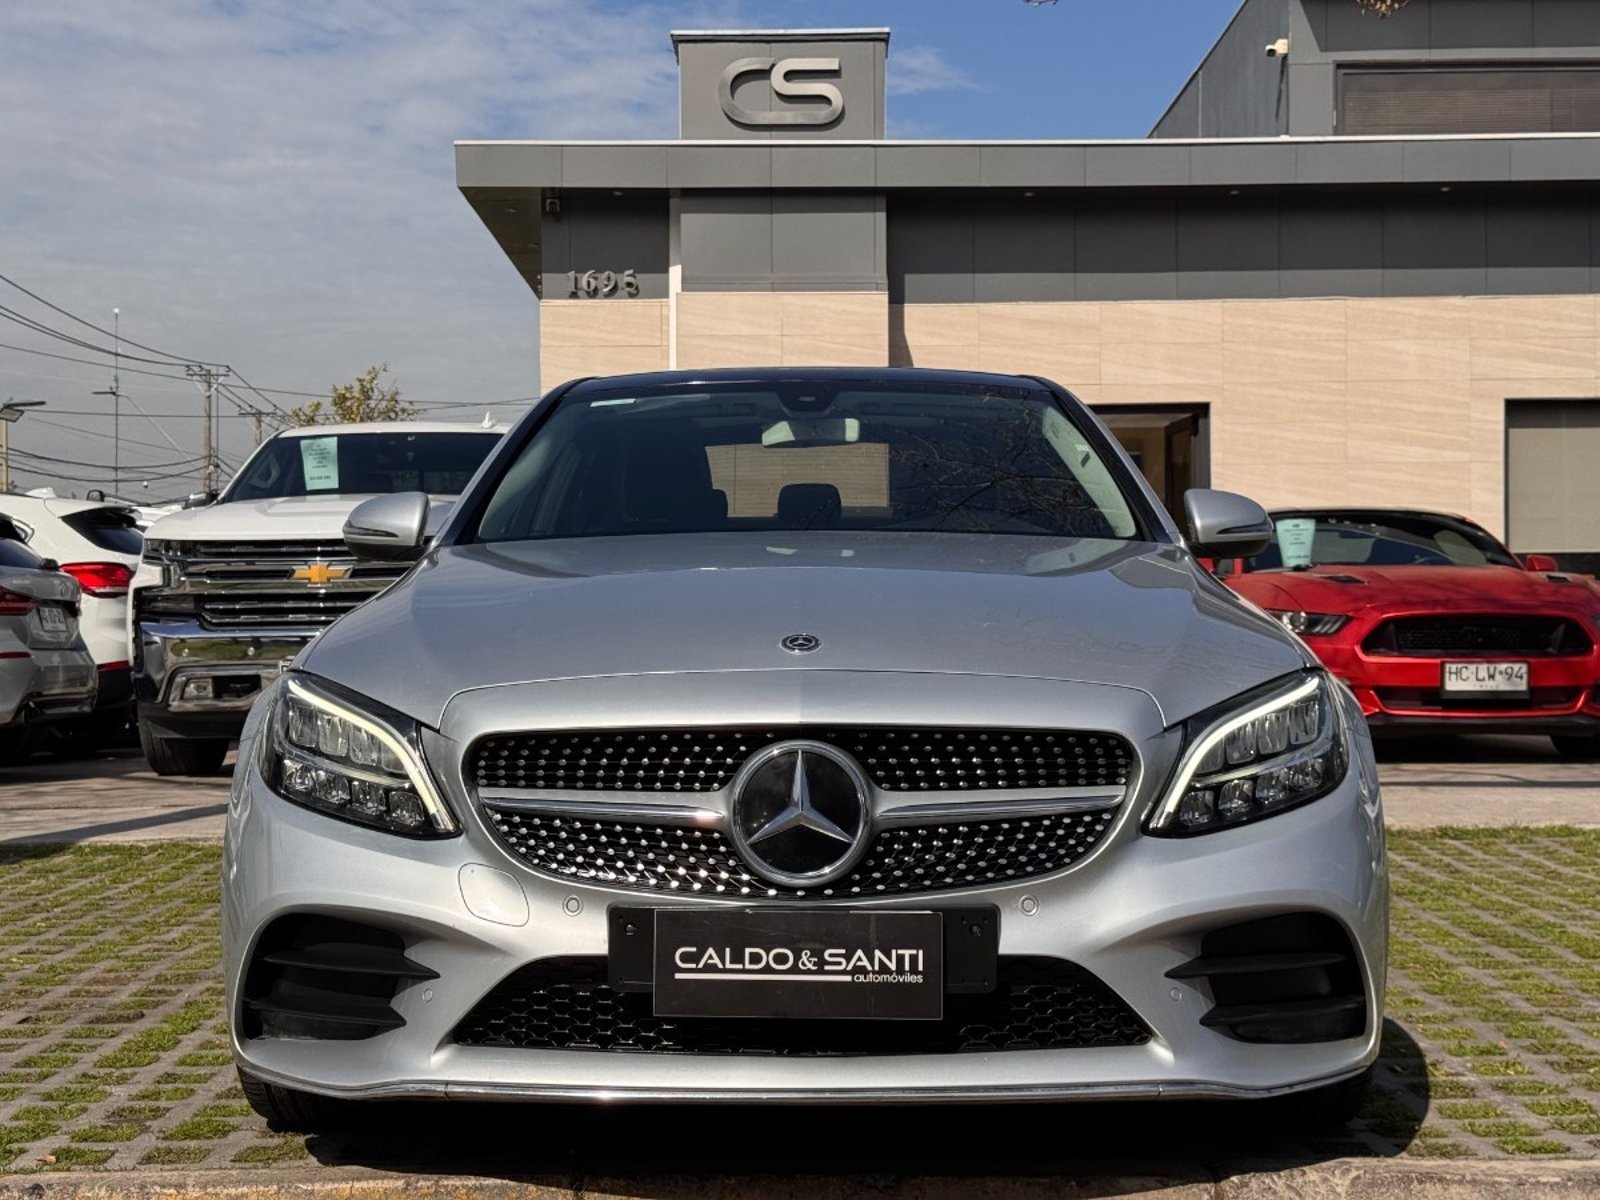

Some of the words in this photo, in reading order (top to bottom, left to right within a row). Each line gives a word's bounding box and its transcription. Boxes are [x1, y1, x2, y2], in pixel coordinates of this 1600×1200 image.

[718, 57, 844, 125] CS
[567, 269, 638, 292] 1695
[674, 946, 794, 970] CALDO
[823, 948, 924, 971] SANTI
[853, 972, 924, 984] automóviles
